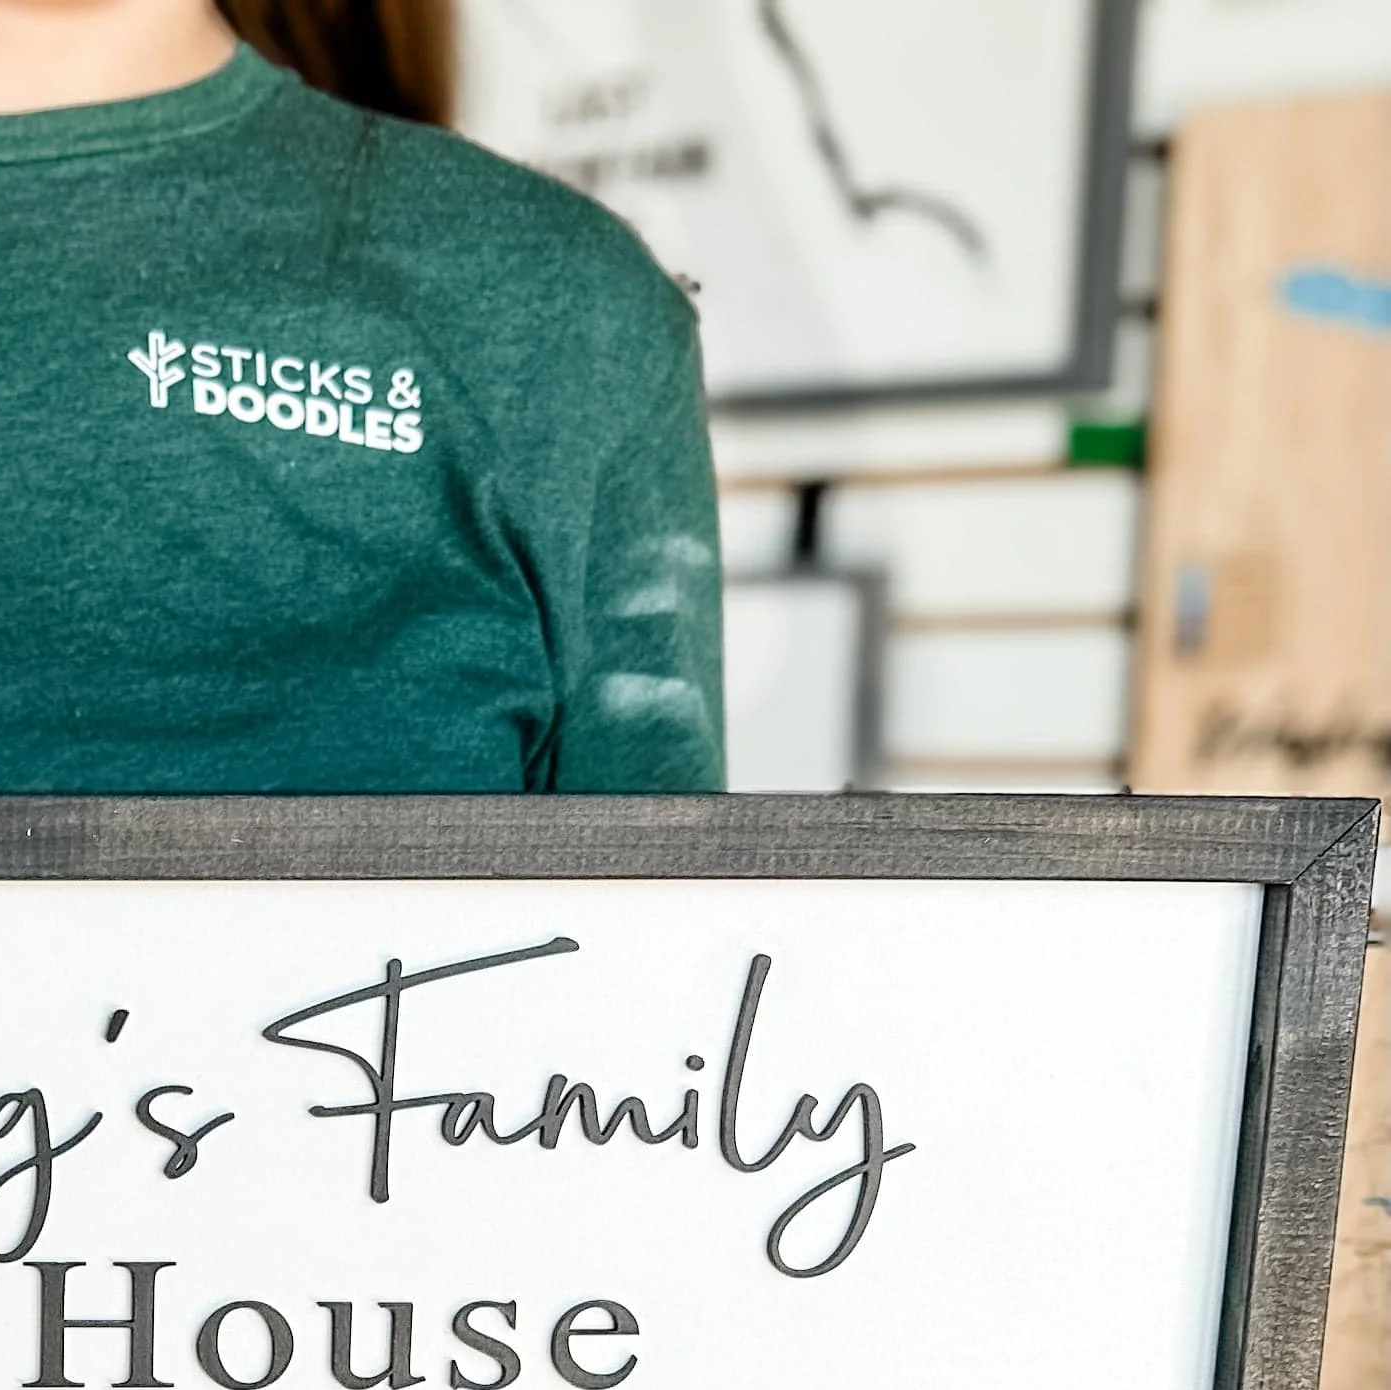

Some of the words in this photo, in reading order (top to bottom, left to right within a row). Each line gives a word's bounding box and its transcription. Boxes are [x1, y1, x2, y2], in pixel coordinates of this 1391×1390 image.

[191, 341, 374, 406] STICKS
[386, 367, 422, 410] &
[191, 377, 425, 455] DOODLES
[262, 936, 917, 1279] Family
